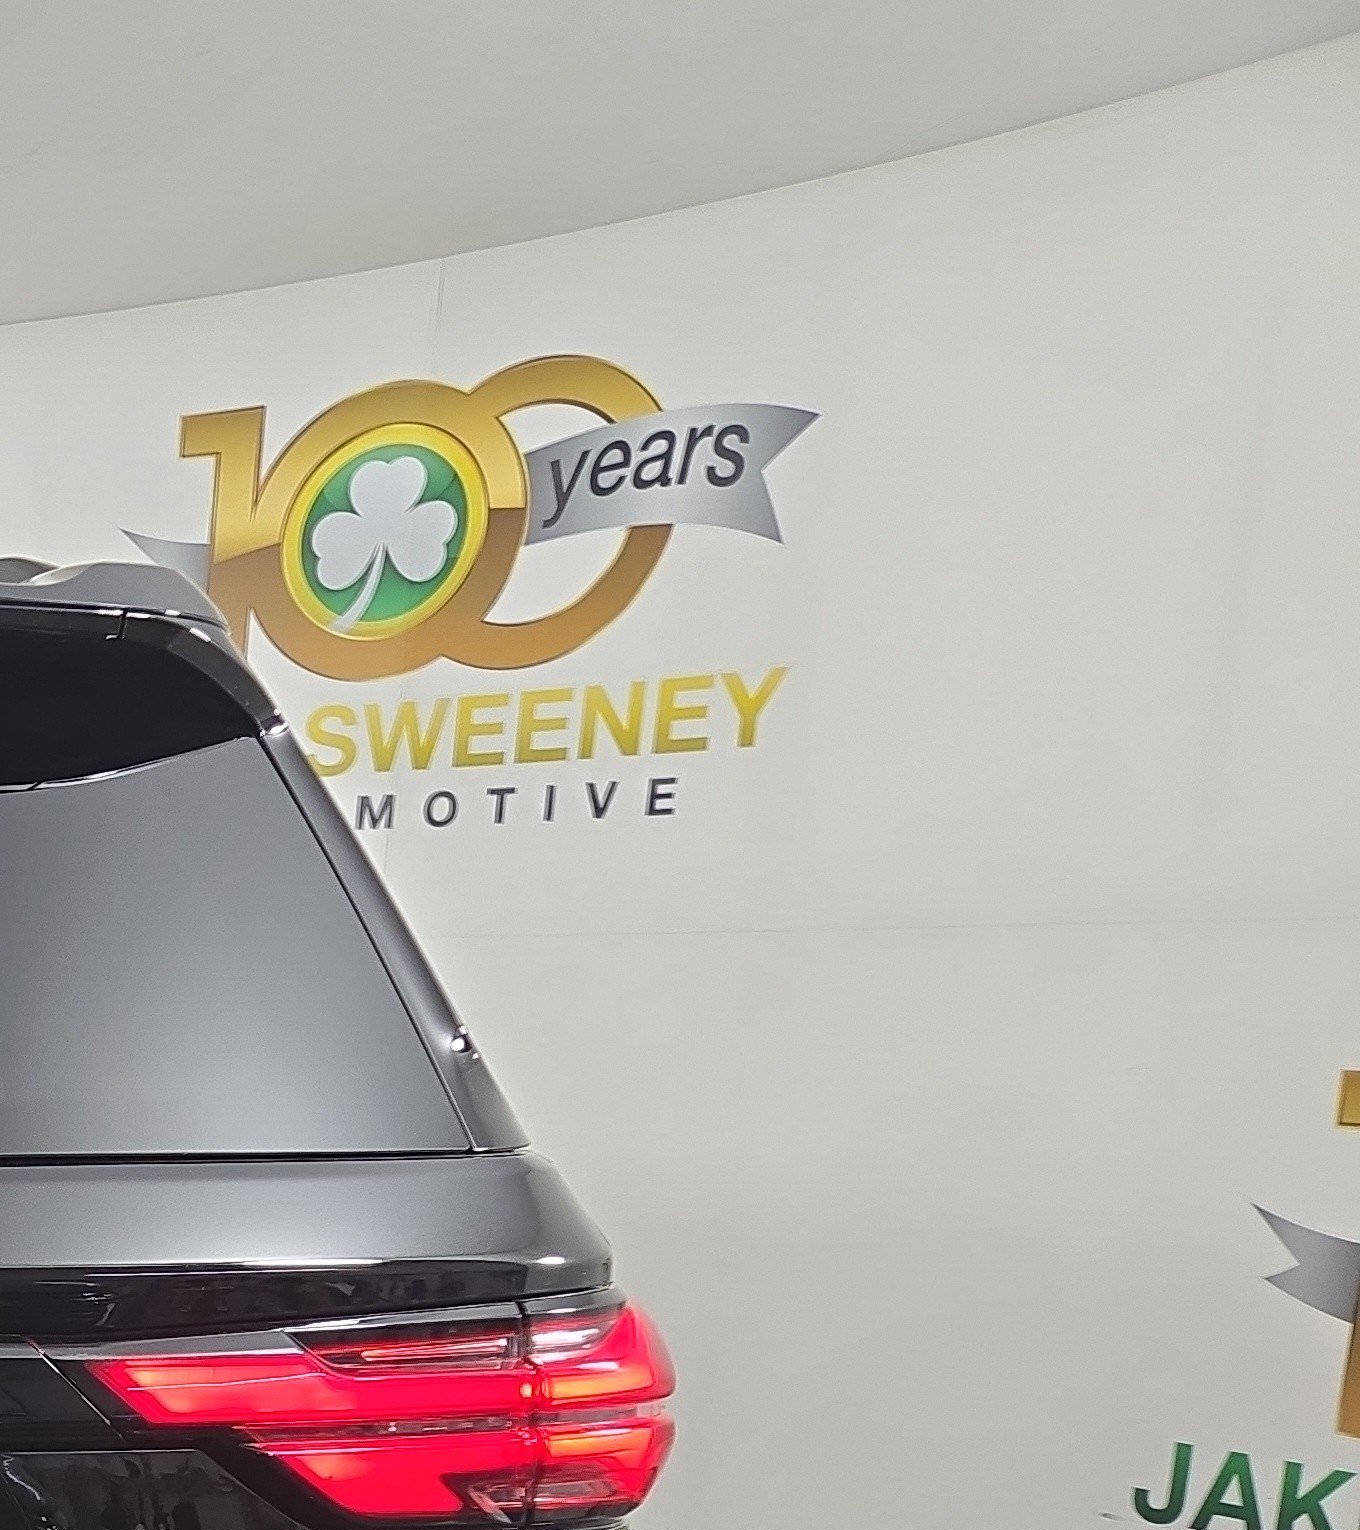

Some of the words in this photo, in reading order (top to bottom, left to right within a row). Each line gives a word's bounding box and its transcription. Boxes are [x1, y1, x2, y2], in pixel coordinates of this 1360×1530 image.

[541, 421, 751, 529] years
[304, 666, 790, 778] SWEENEY
[354, 776, 680, 832] MOTIVE
